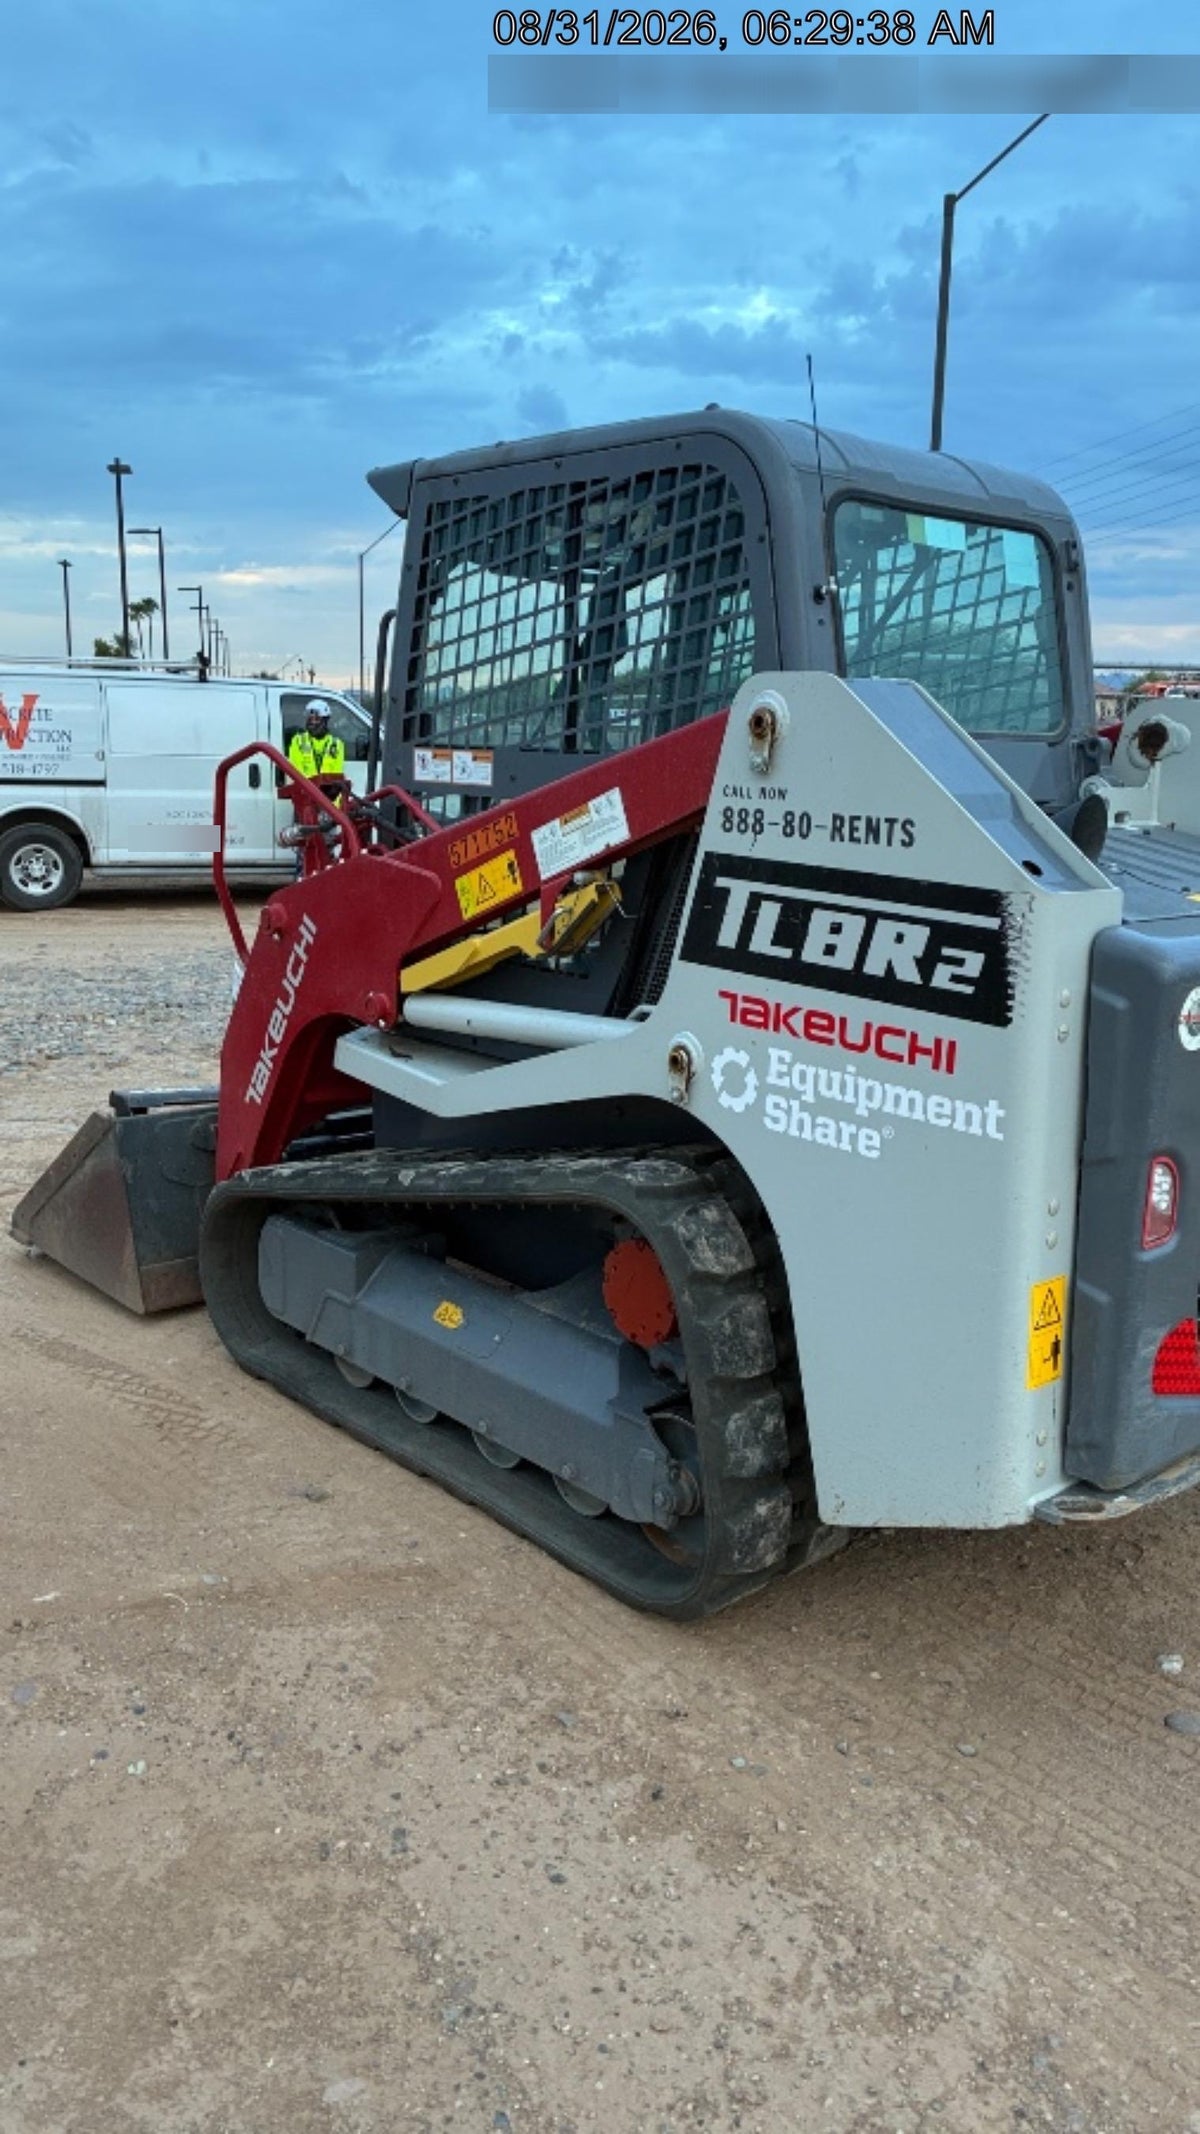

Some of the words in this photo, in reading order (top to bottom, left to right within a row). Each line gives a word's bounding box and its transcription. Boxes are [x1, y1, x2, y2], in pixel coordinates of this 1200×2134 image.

[722, 784, 752, 800] CALL
[758, 786, 788, 801] NOW
[721, 806, 916, 848] 888-80-RENTS
[765, 1047, 1007, 1141] Equipment
